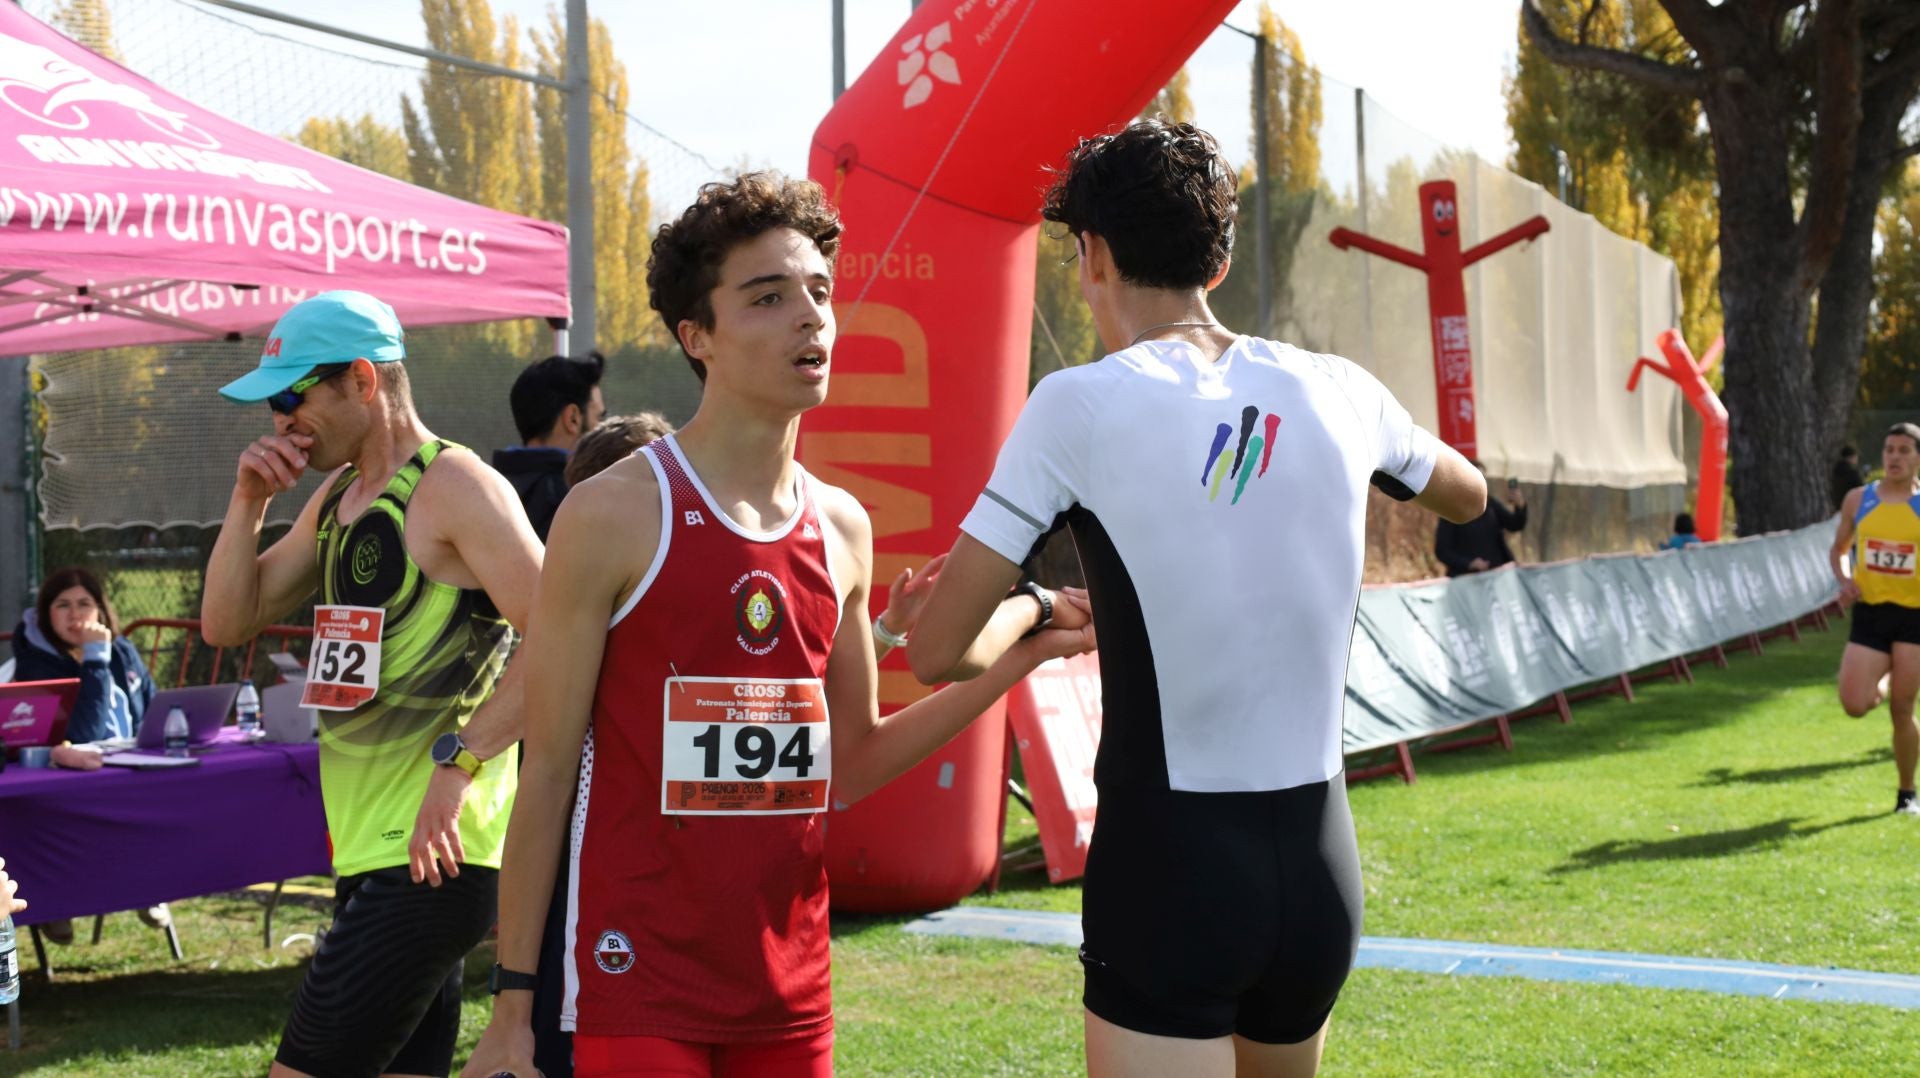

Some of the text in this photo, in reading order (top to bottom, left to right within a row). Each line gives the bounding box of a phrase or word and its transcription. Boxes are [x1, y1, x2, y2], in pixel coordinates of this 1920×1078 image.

[840, 242, 935, 280] encia
[1872, 551, 1908, 567] 137
[730, 569, 788, 599] CLUB ATLETISMO
[736, 634, 779, 655] VALLADOLID
[313, 640, 366, 684] 152
[733, 684, 786, 698] CROSS
[696, 698, 735, 707] Patronato
[736, 700, 775, 709] Municipal
[776, 700, 785, 708] de
[726, 708, 791, 721] Palencia
[693, 725, 813, 779] 194
